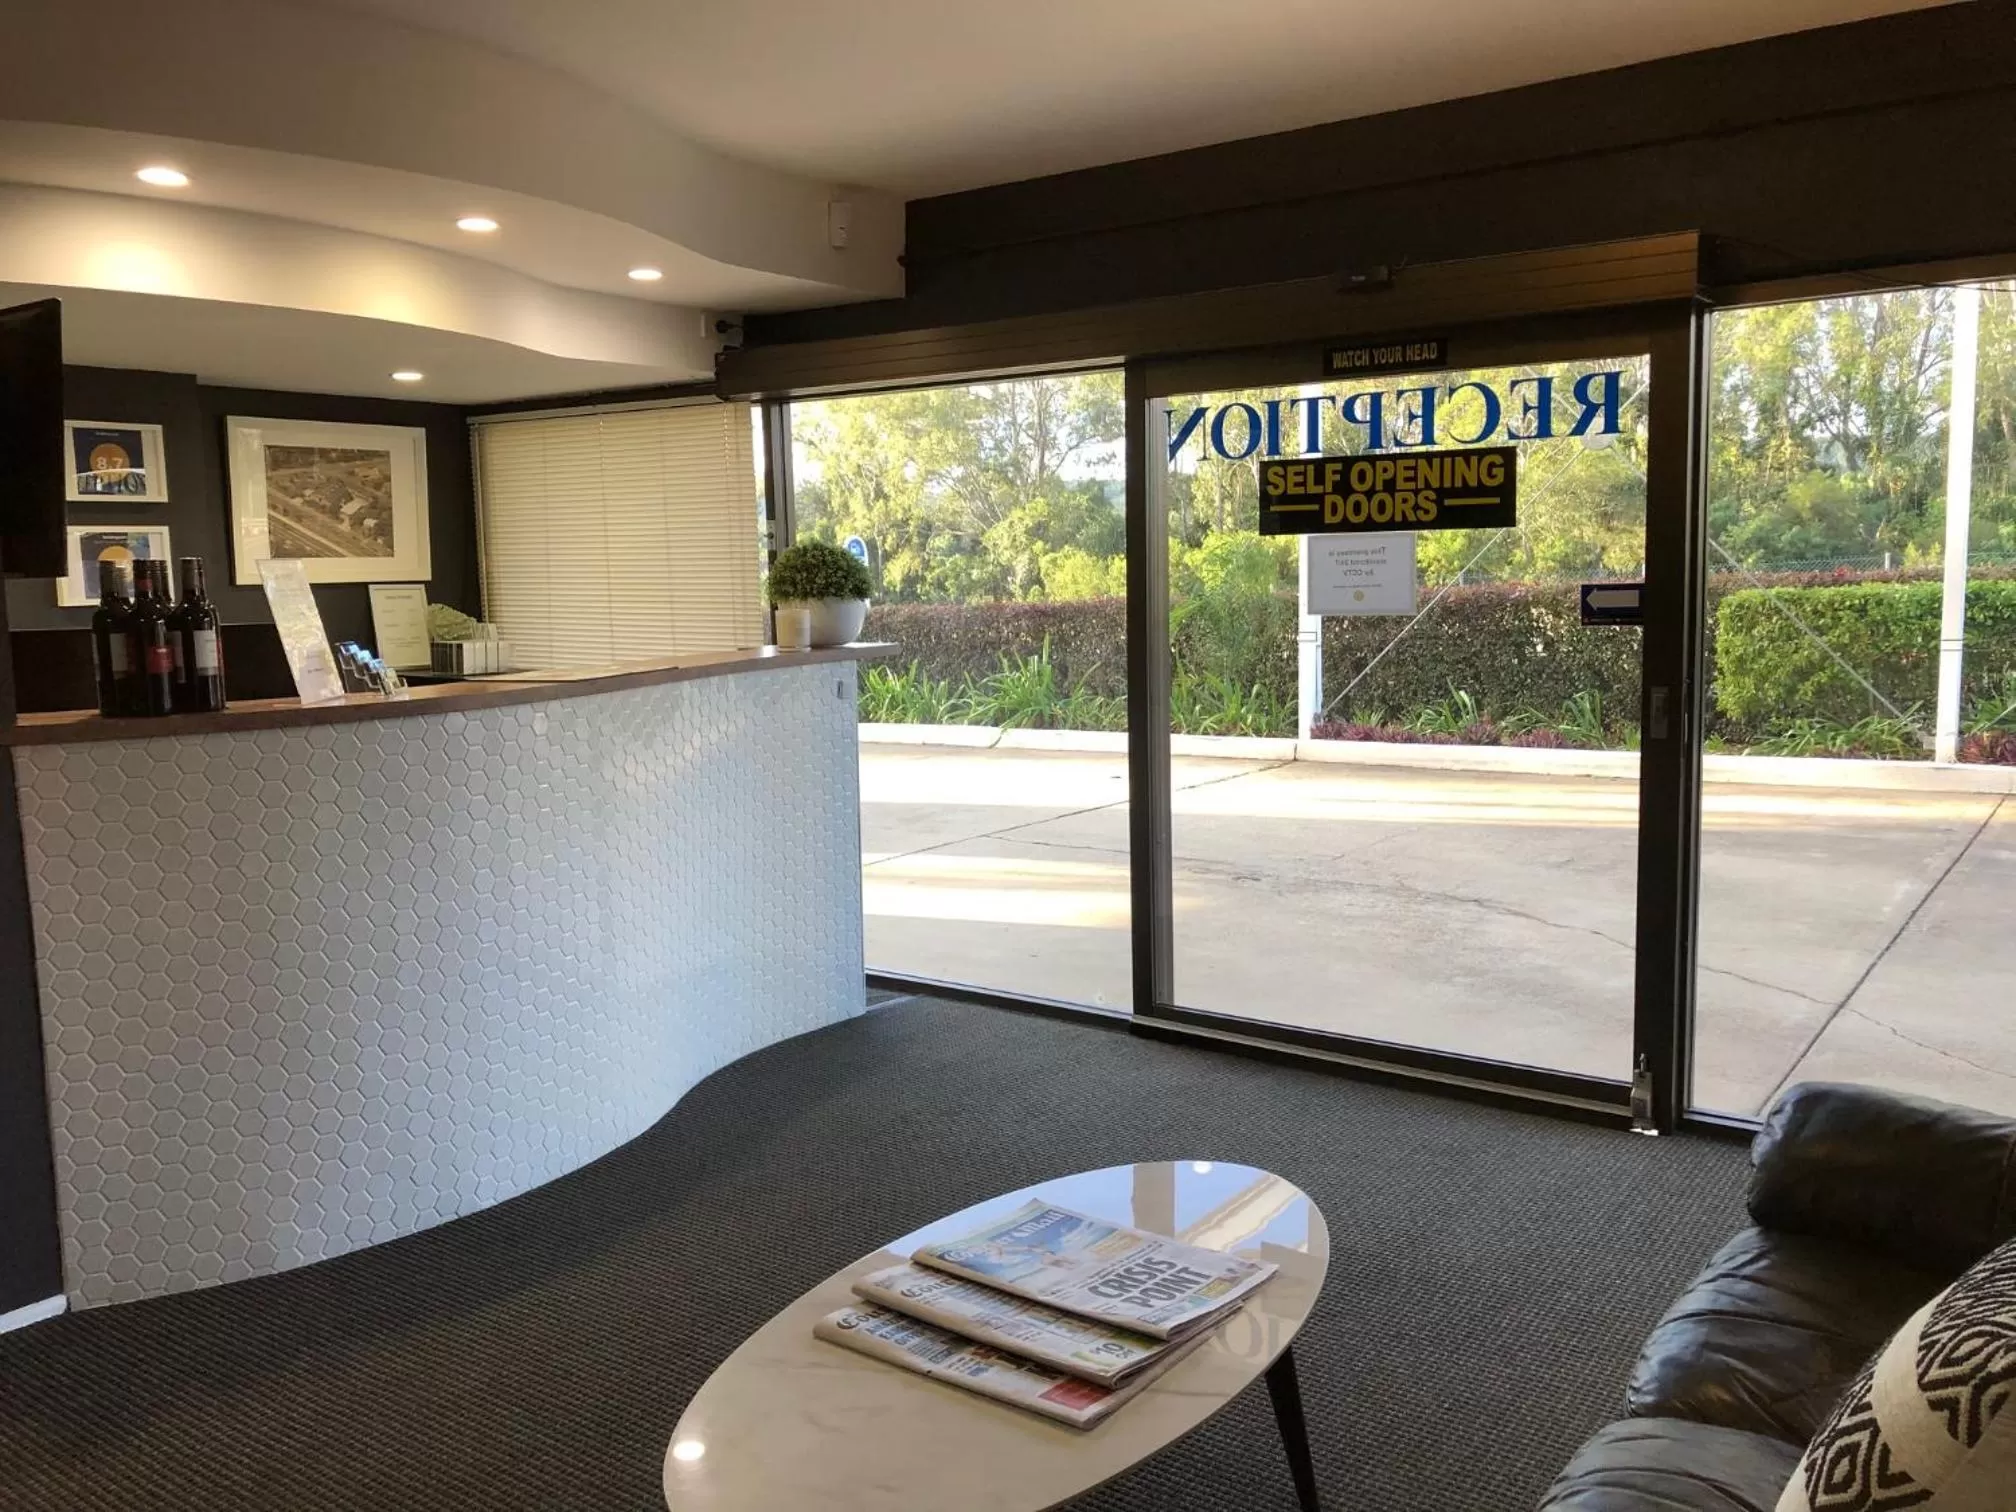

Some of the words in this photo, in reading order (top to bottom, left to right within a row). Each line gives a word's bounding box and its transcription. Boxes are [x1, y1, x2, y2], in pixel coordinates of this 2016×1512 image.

[1332, 348, 1369, 369] WATCH
[1372, 345, 1403, 365] YOUR
[1406, 342, 1438, 362] HEAD
[1266, 462, 1342, 496] SELF
[1349, 453, 1505, 491] OPENING
[1323, 490, 1438, 524] DOORS
[1088, 1257, 1180, 1301] CRISIS
[1121, 1264, 1214, 1309] POINT
